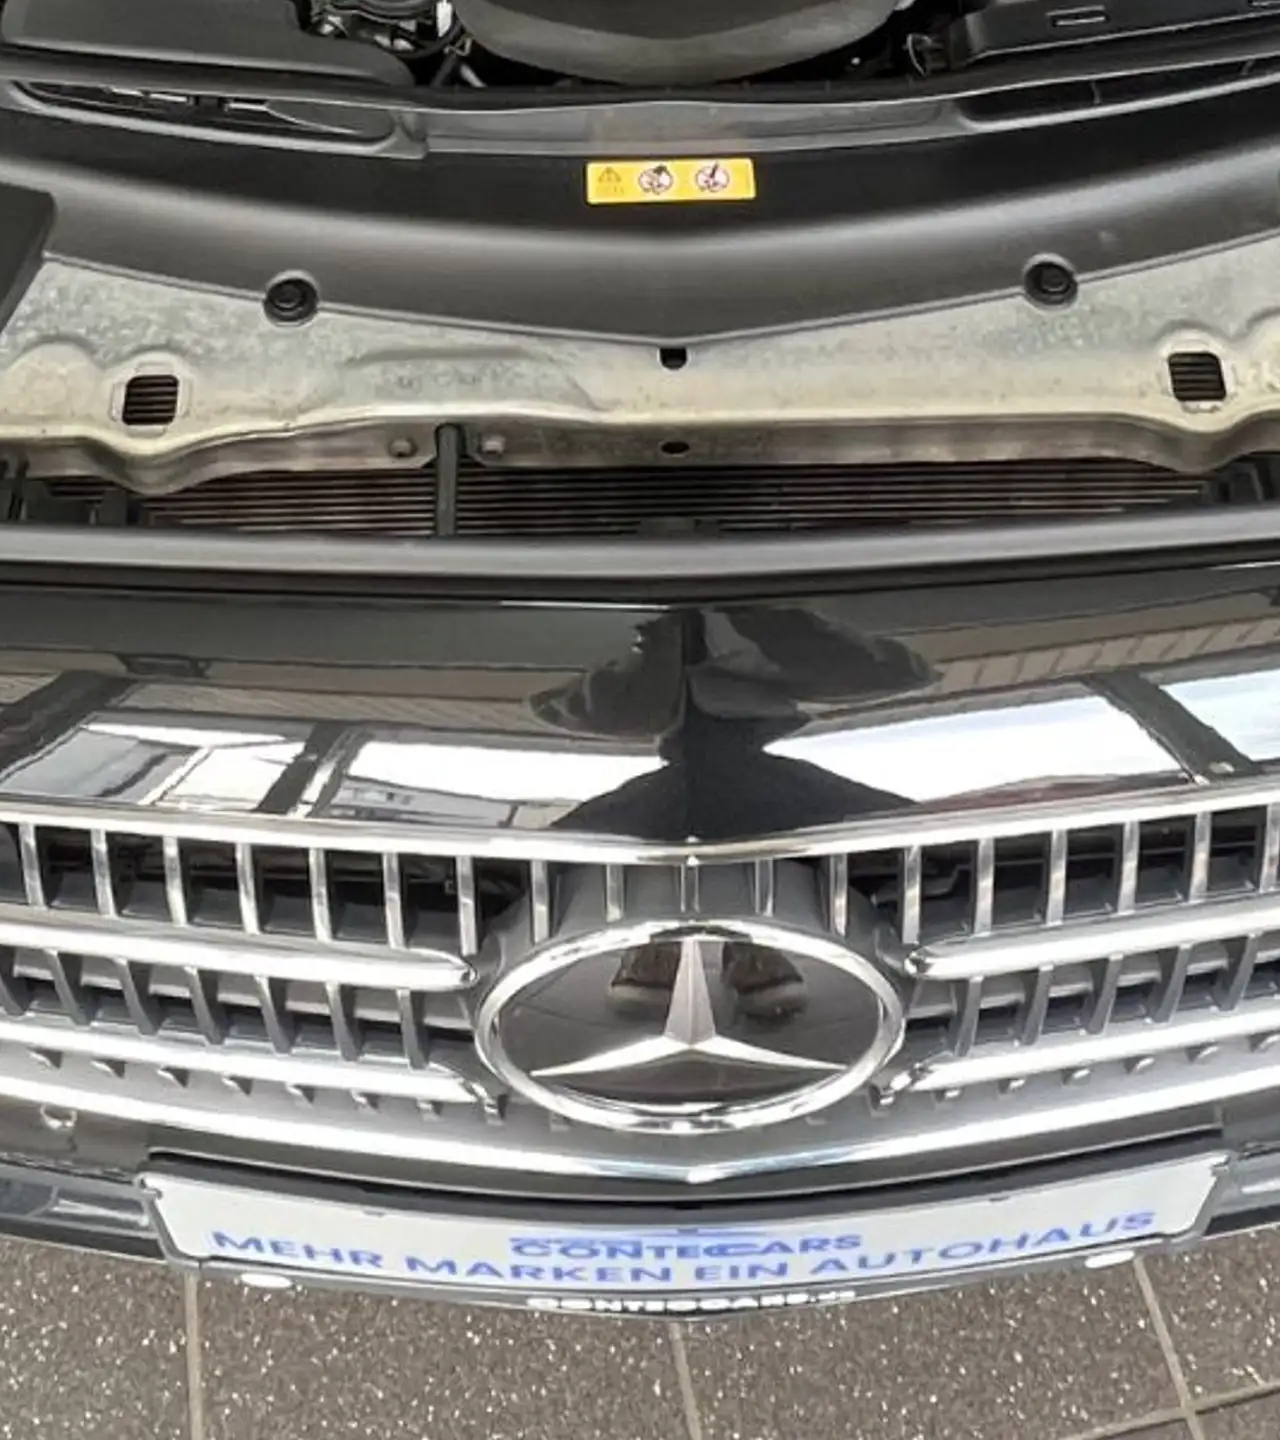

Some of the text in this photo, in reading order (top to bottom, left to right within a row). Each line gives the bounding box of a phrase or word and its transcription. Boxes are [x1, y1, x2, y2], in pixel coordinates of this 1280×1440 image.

[211, 1212, 1155, 1282] MEHR MARKEN EIN AUTOHAUS
